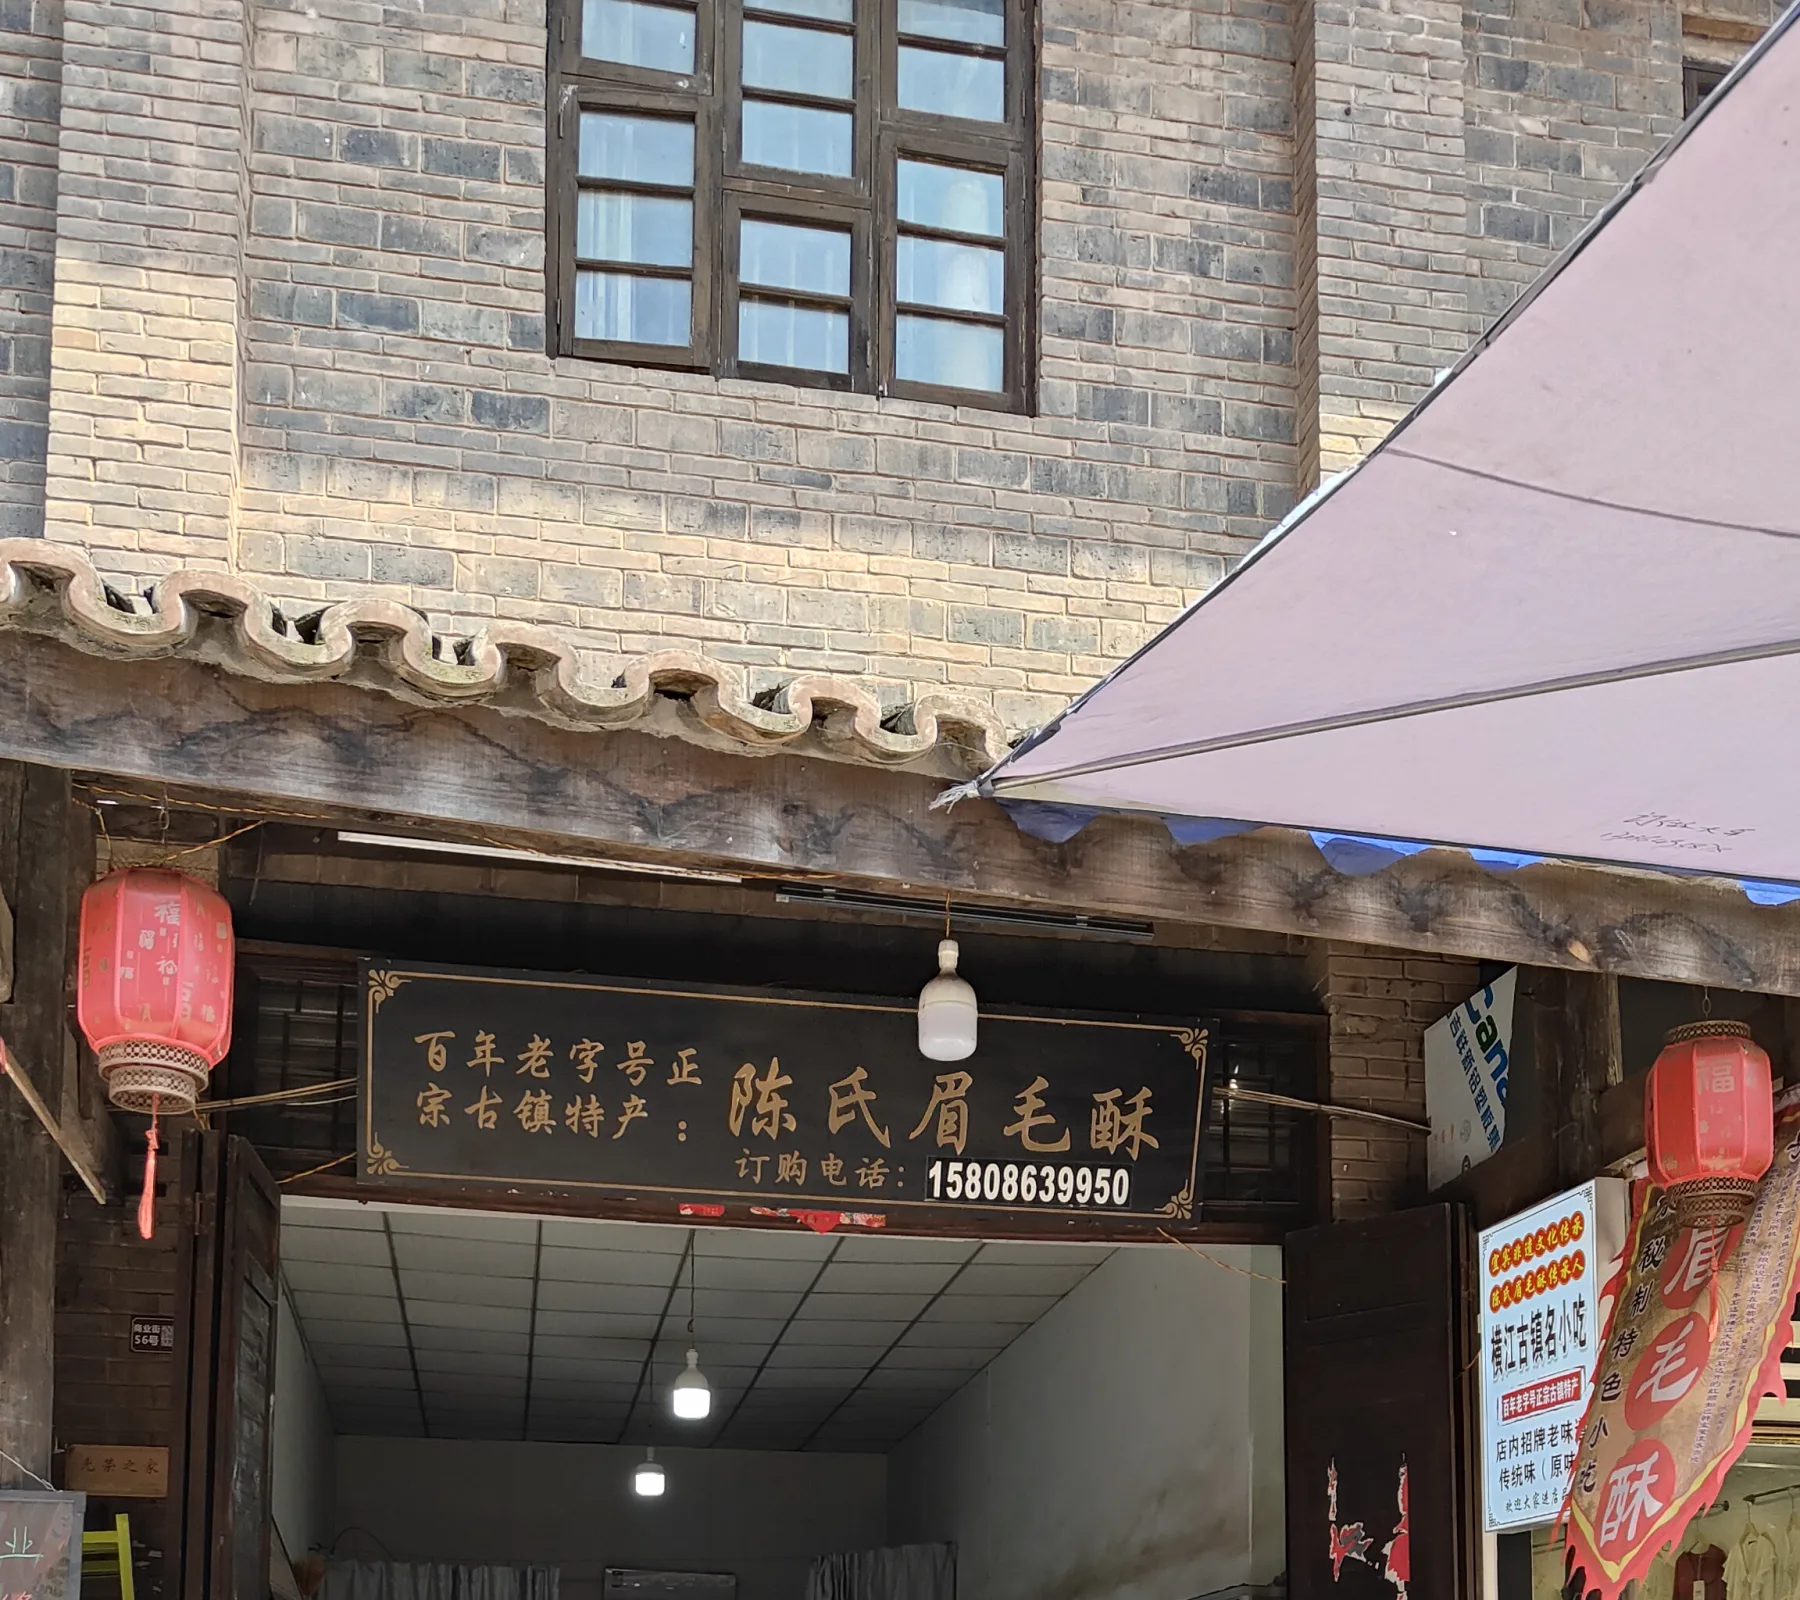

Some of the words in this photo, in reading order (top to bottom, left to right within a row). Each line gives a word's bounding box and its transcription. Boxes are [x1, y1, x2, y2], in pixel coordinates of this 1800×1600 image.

[413, 1029, 703, 1088] 百年老字号正
[414, 1083, 691, 1145] 宗古镇特产：
[728, 1057, 1162, 1159] 陈氏眉毛酥
[928, 1159, 1131, 1206] 15808639950
[1490, 1213, 1585, 1275] 宜宾非遗文化传承
[1491, 1257, 1585, 1310] 陈氏眉毛酥传承人
[133, 1323, 161, 1334] 商业街
[133, 1335, 160, 1346] 56号
[1491, 1293, 1588, 1377] 横江古镇名小吃
[1502, 1377, 1580, 1418] 百年老字号正宗古镇特产
[80, 1456, 160, 1475] 光荣之家
